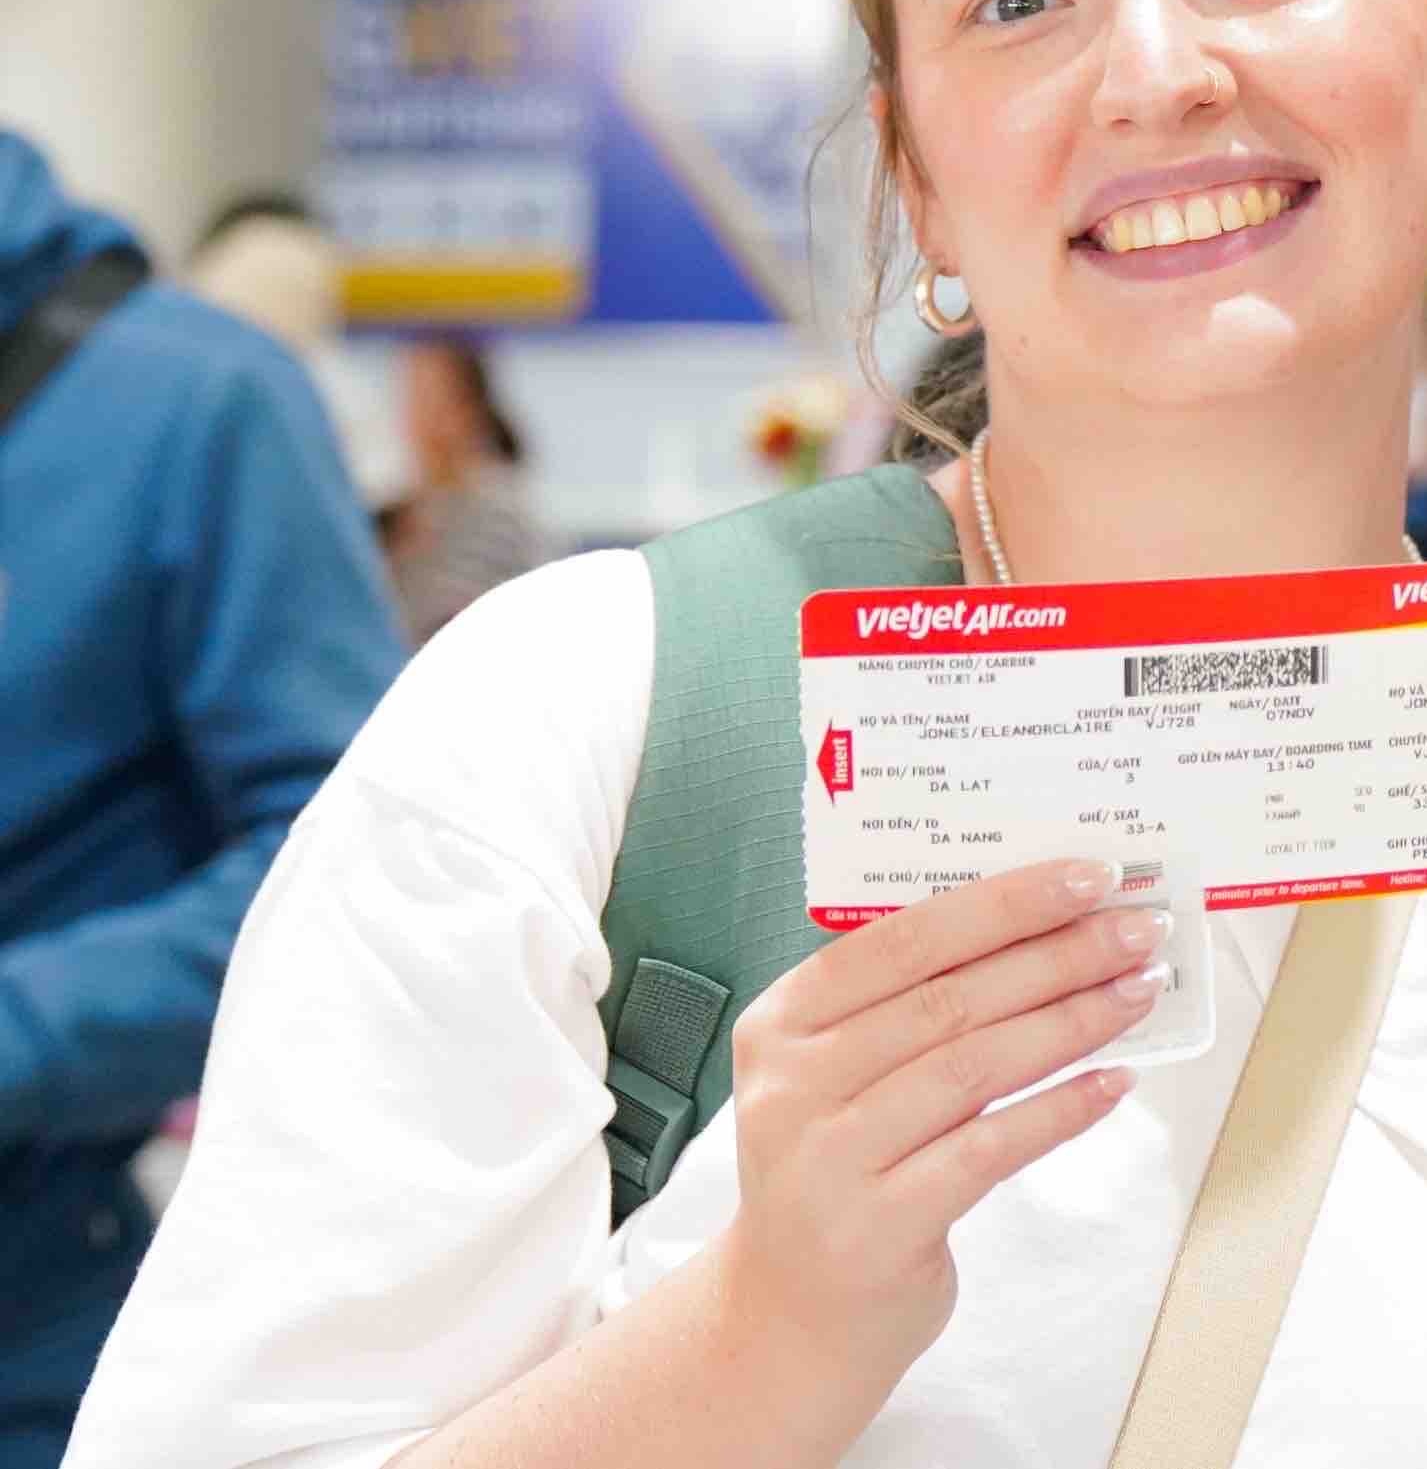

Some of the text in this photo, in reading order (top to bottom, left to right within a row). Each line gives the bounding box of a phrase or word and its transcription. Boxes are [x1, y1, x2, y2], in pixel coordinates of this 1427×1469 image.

[986, 657, 1035, 668] CARRIER
[1274, 695, 1302, 707] DATE
[1127, 703, 1160, 720] BAY/
[1162, 702, 1202, 715] FLIGHT
[1266, 707, 1315, 722] 07NOV
[936, 714, 970, 724] NAME
[919, 721, 1112, 740] JONES/ELEANORCLAIRE
[1253, 746, 1283, 761] BAY/
[1286, 740, 1344, 757] BOARDING
[1348, 739, 1373, 752] TIME
[832, 737, 848, 783] insert
[1113, 756, 1142, 769] GATE
[912, 765, 946, 777] FROM
[1126, 772, 1135, 784] 3
[930, 779, 992, 793] DA LAT
[1113, 808, 1140, 822] SEAT
[924, 819, 939, 829] TO
[1125, 821, 1166, 835] 33-A
[930, 832, 1002, 845] DA NANG
[1387, 838, 1408, 850] GHI
[863, 872, 884, 884] GHI
[924, 871, 981, 883] REMARKS
